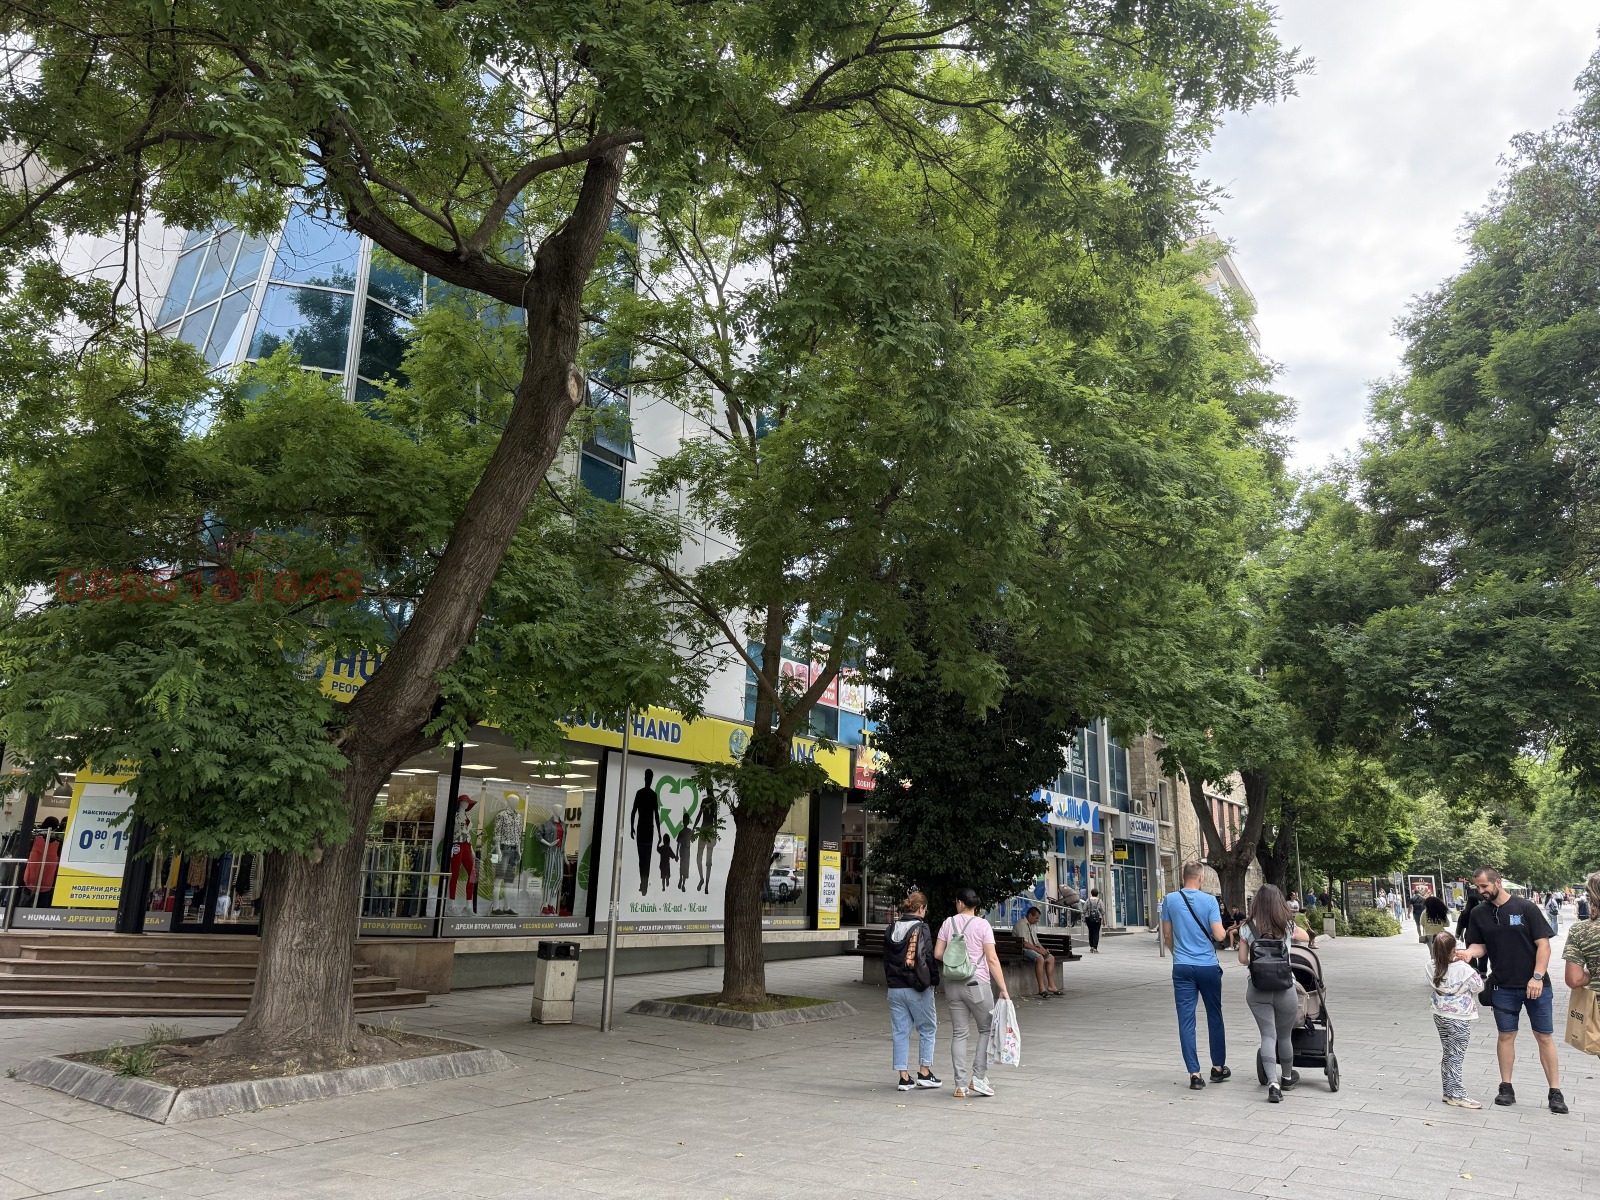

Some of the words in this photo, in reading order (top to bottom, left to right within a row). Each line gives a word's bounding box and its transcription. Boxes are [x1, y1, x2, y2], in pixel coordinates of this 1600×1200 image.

[333, 648, 382, 681] HU
[331, 681, 359, 695] PEOP
[633, 714, 682, 744] HAND
[790, 741, 816, 763] ANA
[72, 885, 104, 893] МОДЕРНИ
[28, 914, 61, 922] HUMANA
[68, 915, 94, 923] ДРЕХИ
[145, 917, 160, 925] ЕБА
[363, 922, 386, 930] ВТОРА
[455, 923, 474, 931] ДРЕХИ
